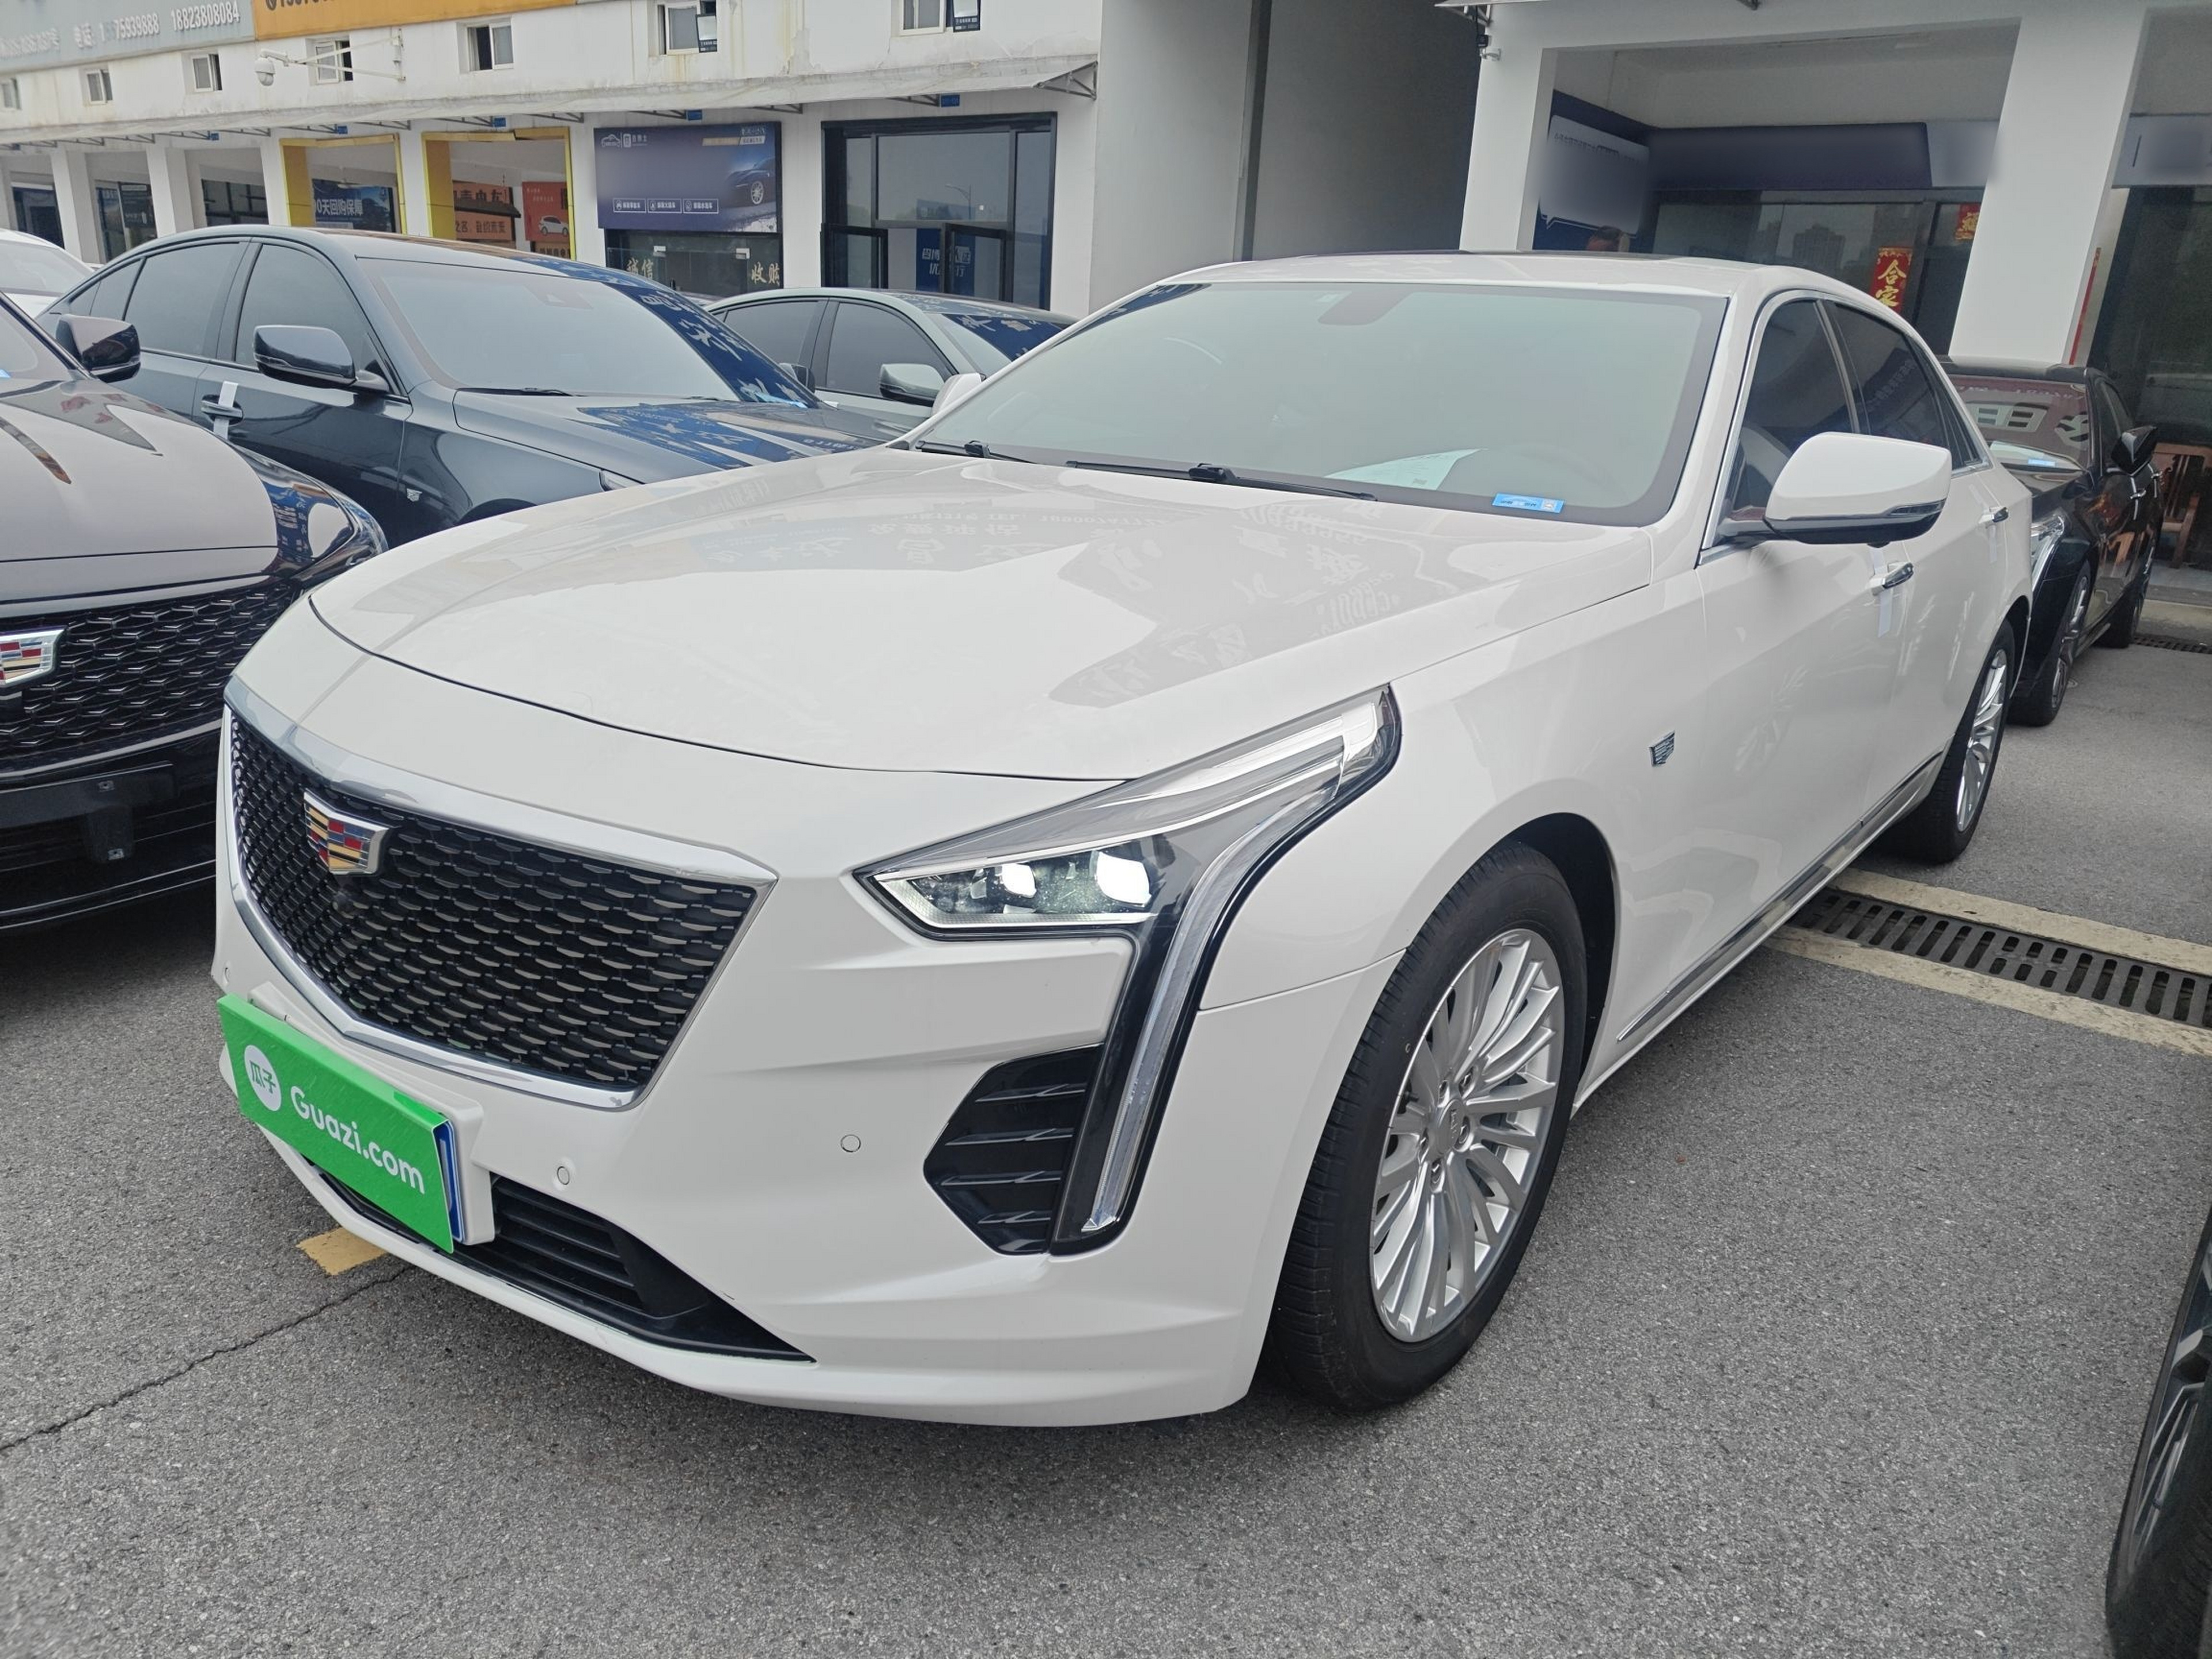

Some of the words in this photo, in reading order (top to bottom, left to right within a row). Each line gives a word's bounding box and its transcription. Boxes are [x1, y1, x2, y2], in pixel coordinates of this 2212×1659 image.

[170, 1, 240, 31] 18823808084
[249, 1059, 276, 1094] 瓜子
[290, 1085, 426, 1195] Guazi.com
